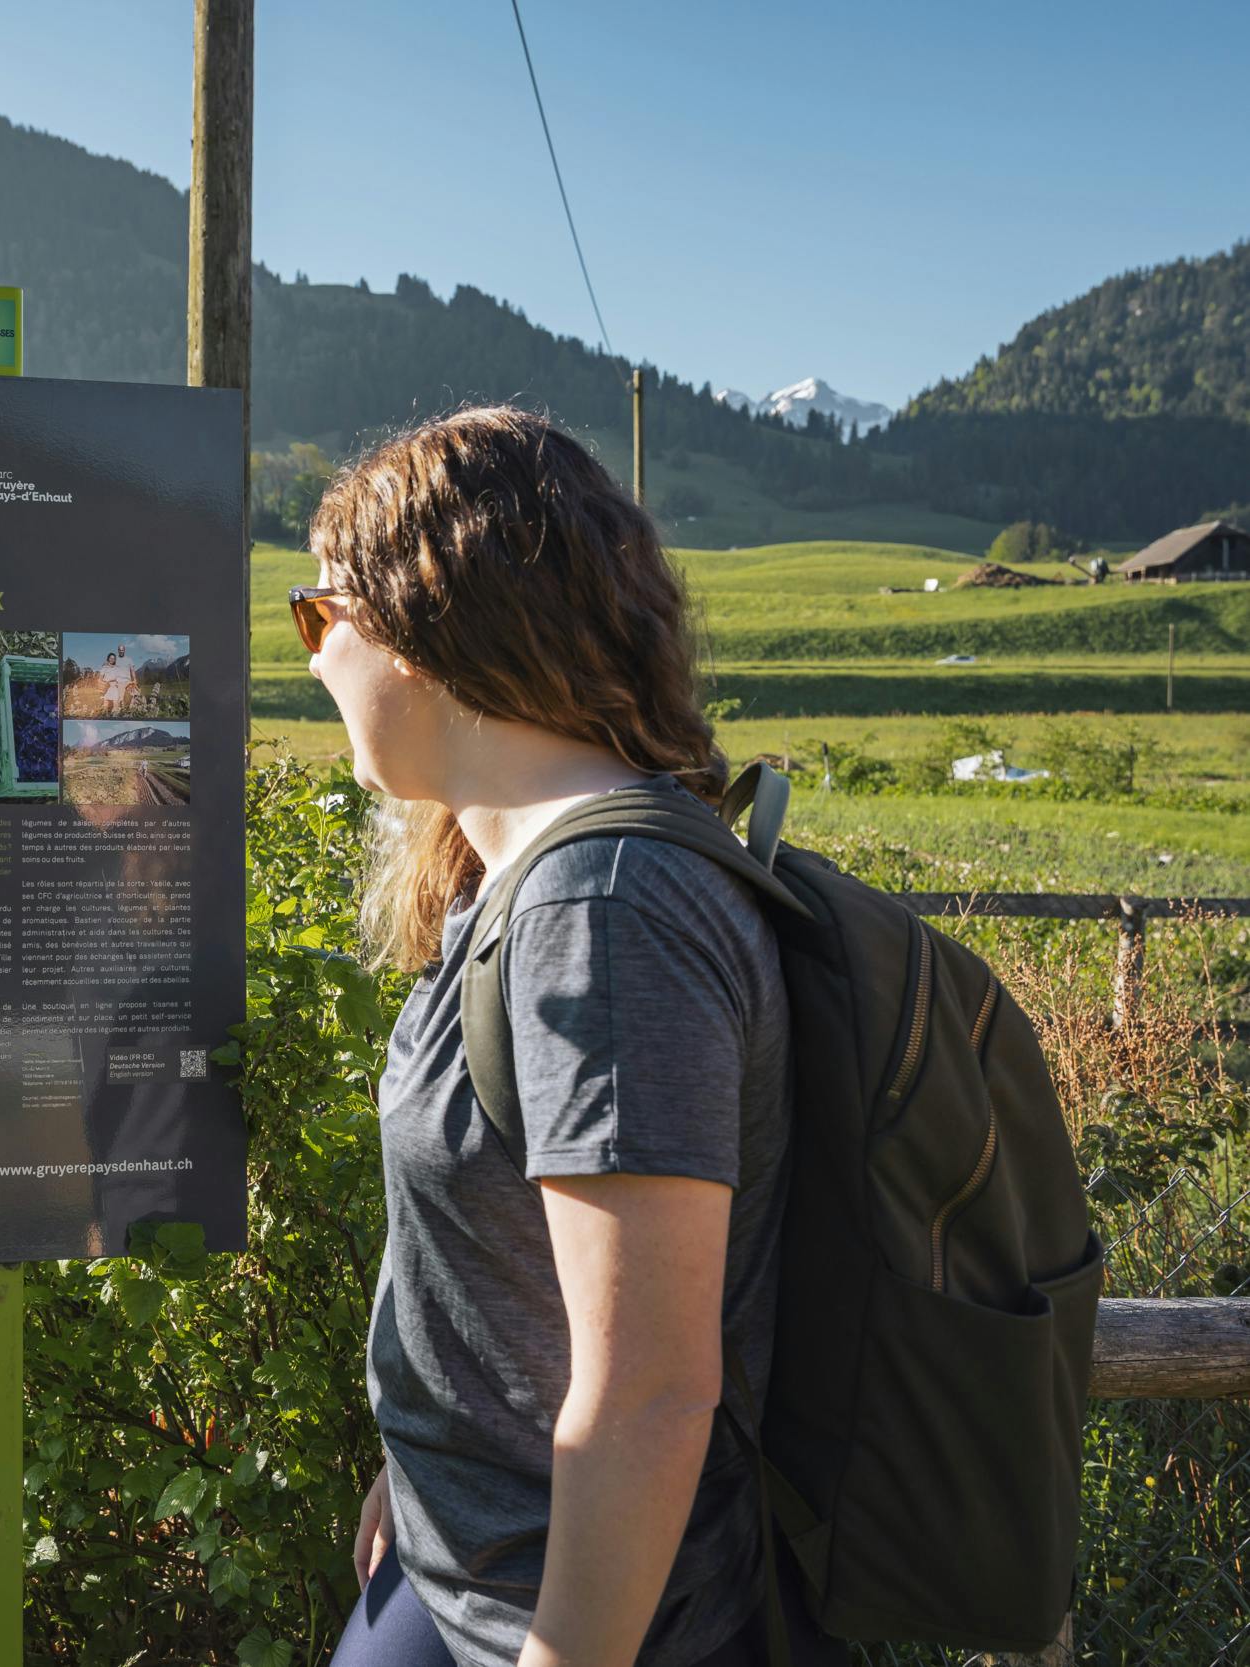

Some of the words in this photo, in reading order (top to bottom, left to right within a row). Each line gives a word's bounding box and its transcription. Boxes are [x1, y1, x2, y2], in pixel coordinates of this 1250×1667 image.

[22, 831, 52, 841] légumes
[65, 831, 102, 841] production
[103, 831, 126, 839] Suisse
[168, 833, 180, 841] que
[22, 843, 44, 854] temps
[54, 843, 77, 851] autres
[80, 843, 92, 851] des
[95, 843, 124, 854] produits
[127, 843, 156, 851] élaborés
[159, 845, 170, 853] par
[173, 843, 190, 851] leurs
[22, 855, 40, 863] soins
[52, 855, 64, 863] des
[66, 855, 86, 863] fruits.
[110, 1062, 140, 1070] Deutsche
[0, 1157, 193, 1178] www.gruyerepaysdenhaut.ch
